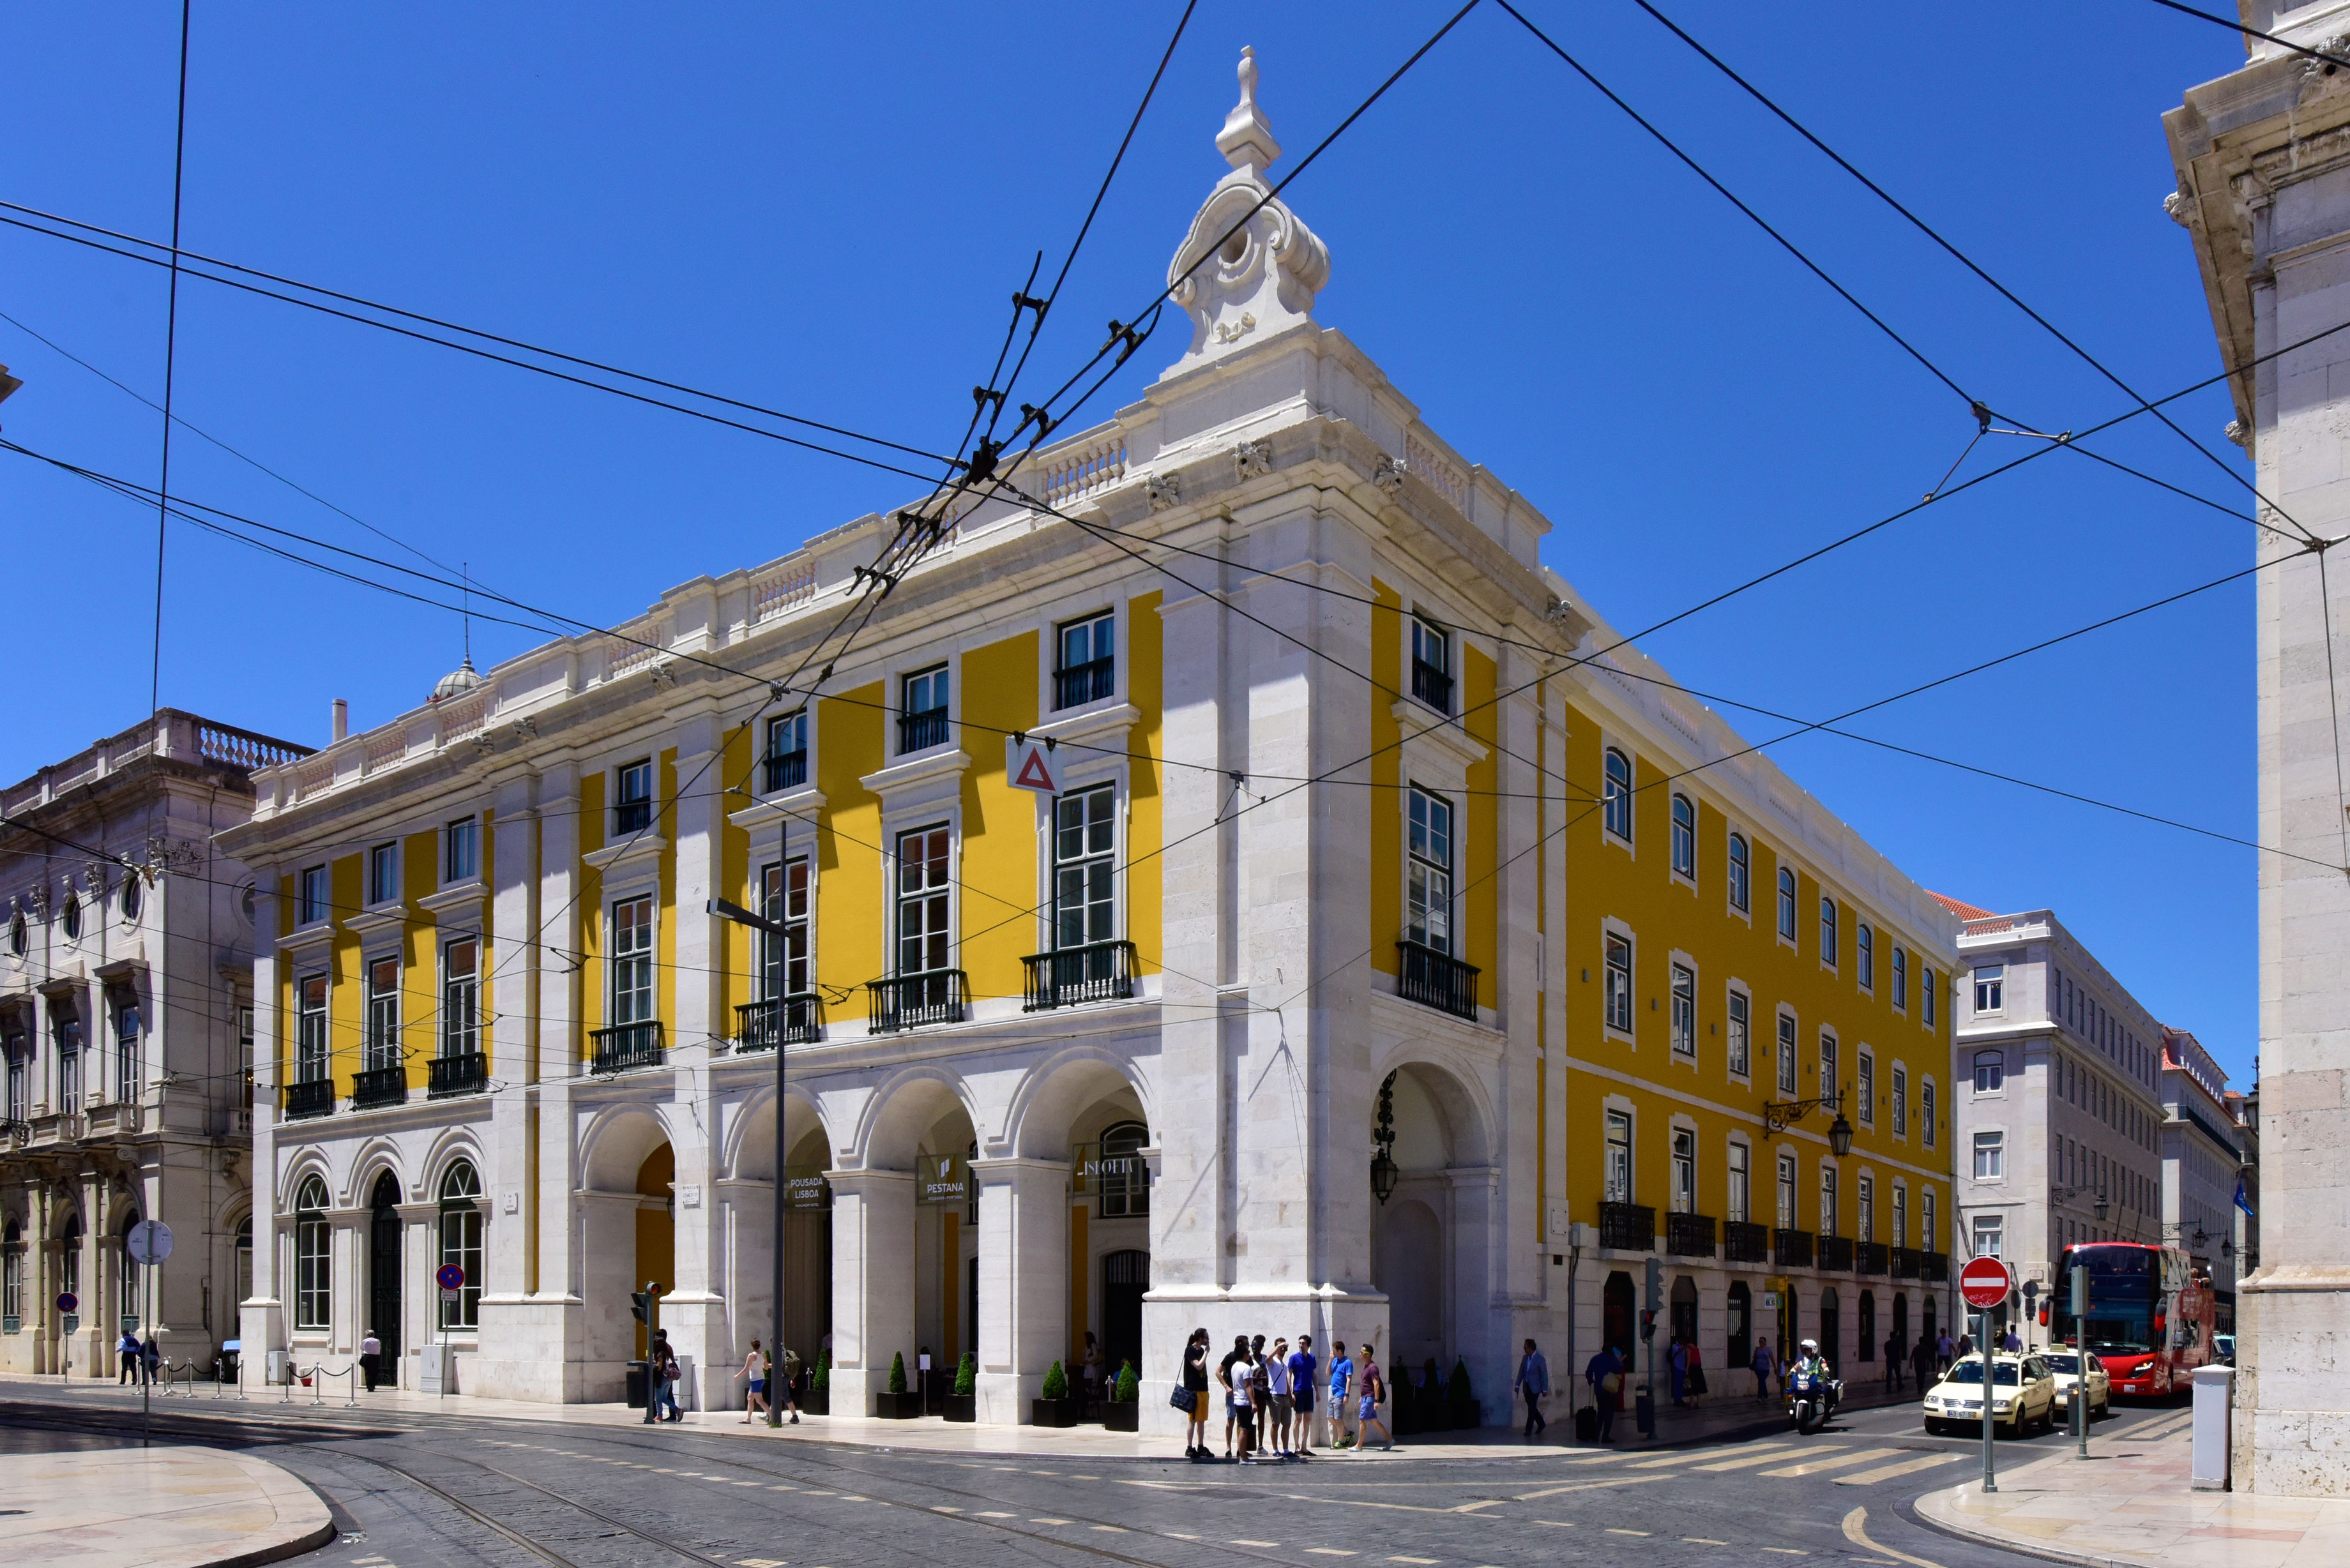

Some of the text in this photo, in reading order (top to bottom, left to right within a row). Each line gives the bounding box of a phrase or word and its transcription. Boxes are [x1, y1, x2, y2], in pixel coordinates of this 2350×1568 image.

[791, 1177, 823, 1187] POUSADA
[927, 1182, 964, 1193] PESTANA
[795, 1189, 819, 1198] LISBOA
